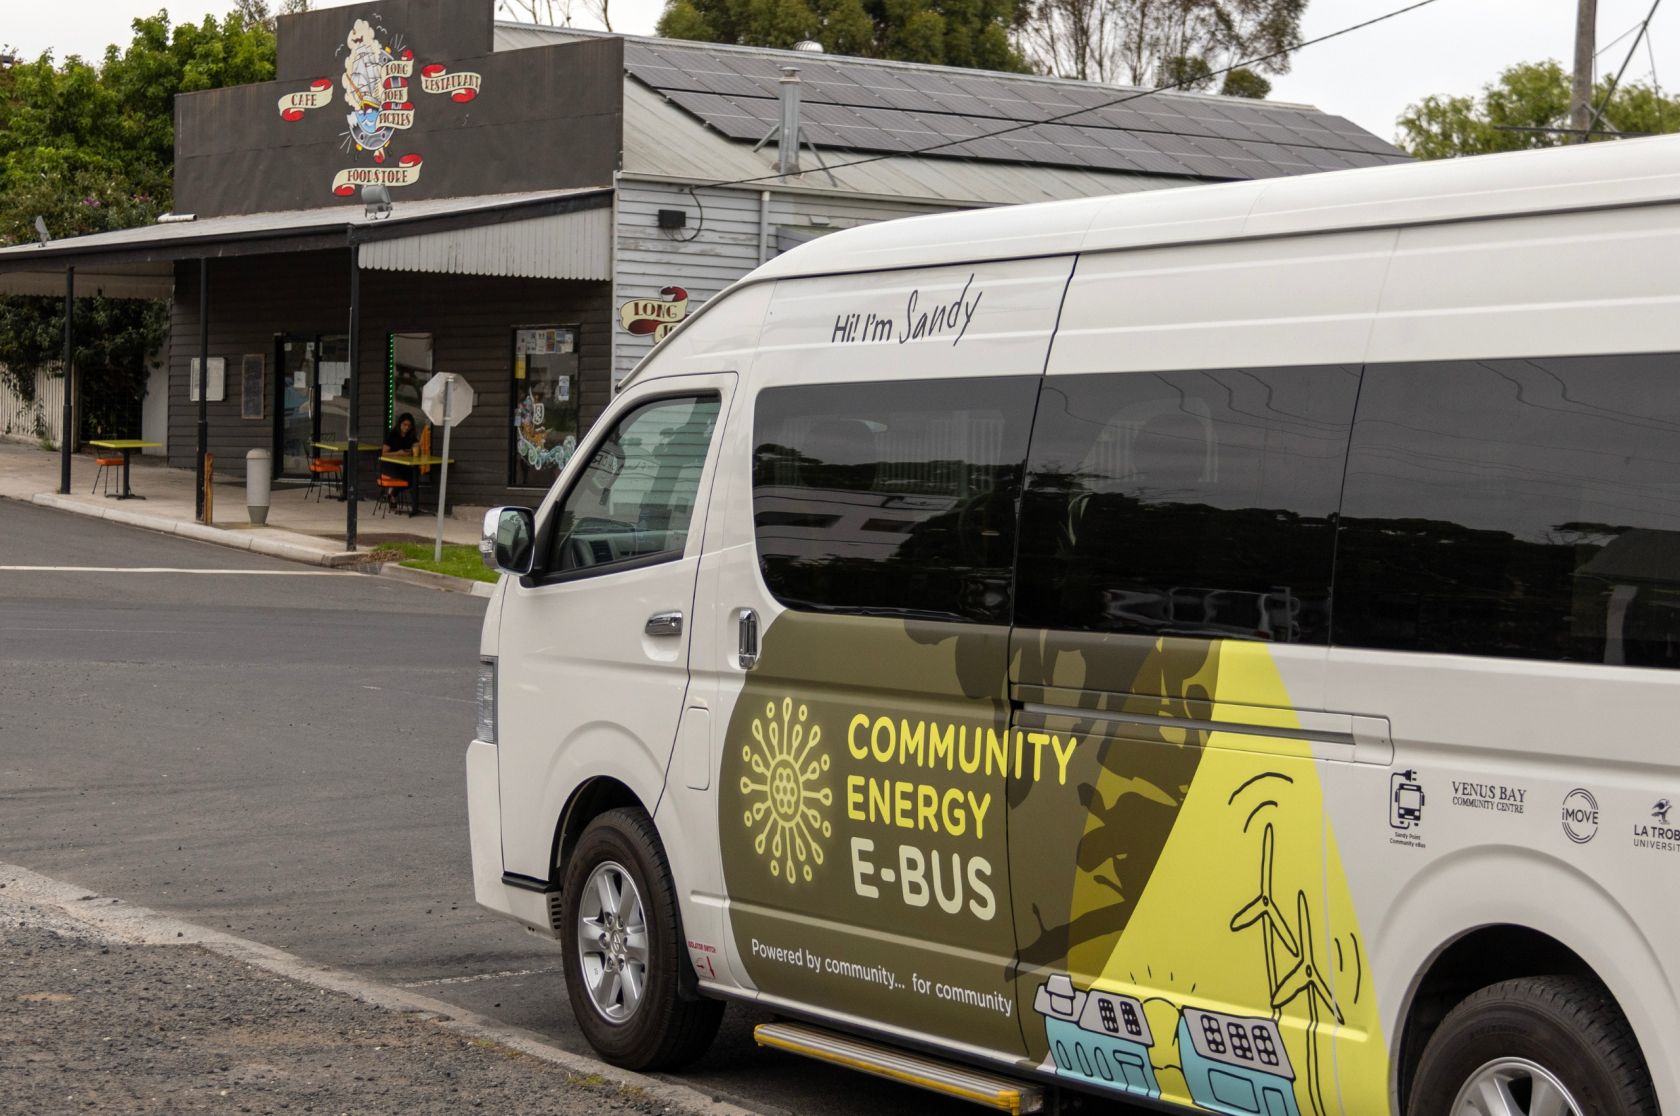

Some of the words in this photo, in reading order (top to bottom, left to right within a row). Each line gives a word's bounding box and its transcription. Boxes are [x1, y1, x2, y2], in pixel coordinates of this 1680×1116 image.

[385, 63, 408, 75] LONG
[424, 74, 479, 91] RESTAURANT
[291, 93, 317, 107] CAFE
[633, 302, 678, 319] LONG
[831, 313, 861, 344] Hi!
[861, 313, 893, 343] I'm
[899, 273, 983, 347] Sandy
[847, 713, 1078, 786] COMMUNITY
[1452, 780, 1496, 800] VENUS
[1499, 786, 1527, 803] BAY
[847, 775, 991, 840] ENERGY
[1452, 796, 1495, 810] COMMUNITY
[1496, 801, 1525, 814] CENTRE
[1561, 807, 1599, 825] iMOVE
[1634, 824, 1649, 838] LA
[850, 836, 997, 921] E-BUS
[751, 938, 804, 967] Powered
[806, 949, 822, 973] by
[911, 973, 932, 996] for
[935, 983, 1013, 1017] community
